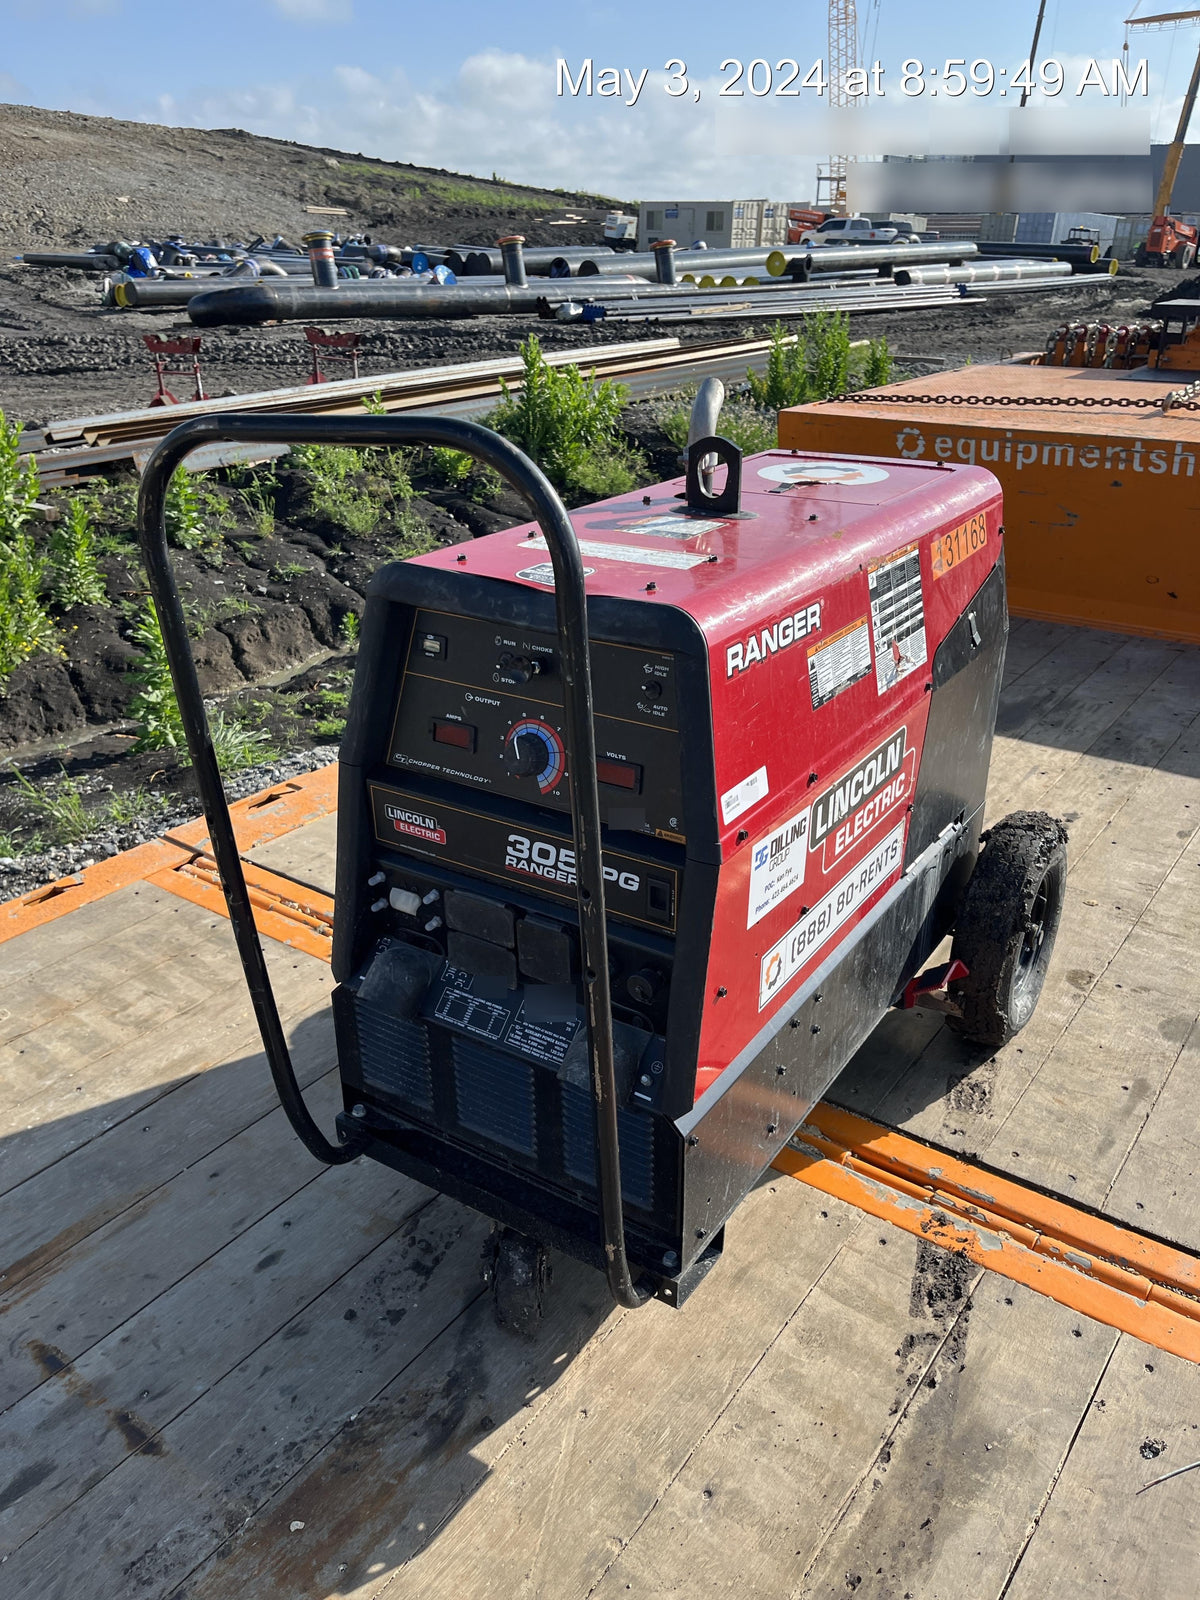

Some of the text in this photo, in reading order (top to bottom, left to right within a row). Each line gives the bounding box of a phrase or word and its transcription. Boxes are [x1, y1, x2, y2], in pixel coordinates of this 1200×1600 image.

[934, 431, 1200, 477] equipmentsh
[503, 639, 517, 647] RUN
[531, 645, 553, 654] CHOKE
[727, 602, 820, 678] RANGER
[654, 664, 669, 672] HIGH
[475, 696, 501, 707] OUTPUT
[652, 704, 669, 712] AUTO
[445, 713, 462, 721] AMPS
[408, 758, 441, 770] CHOPPER
[606, 751, 627, 760] VOLTS
[816, 736, 901, 840] LINCOLN
[387, 807, 435, 830] LINCOLN
[834, 772, 906, 856] ELECTRIC
[399, 822, 441, 841] ELECTRIC
[770, 816, 807, 860] DILLING
[506, 834, 578, 873] 305
[769, 846, 791, 872] GROUP
[791, 837, 898, 964] (888) 80-RENTS
